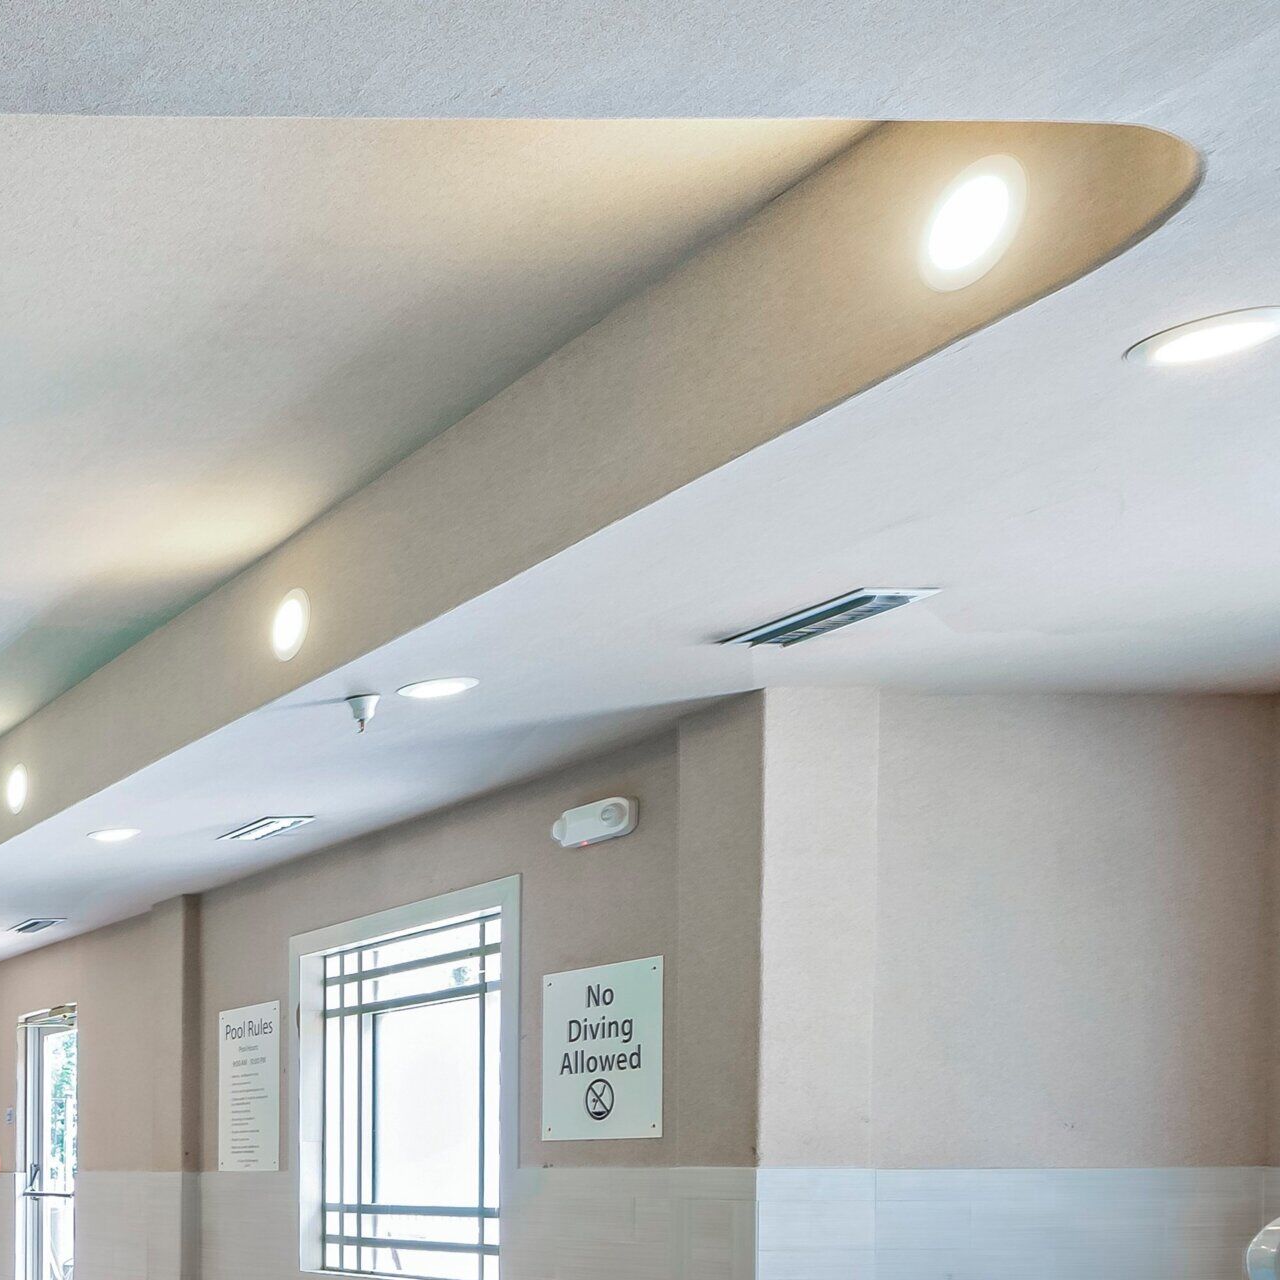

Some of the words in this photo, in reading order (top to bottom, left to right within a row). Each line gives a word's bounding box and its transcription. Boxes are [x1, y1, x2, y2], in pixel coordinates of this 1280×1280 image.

[586, 983, 615, 1008] No
[225, 1020, 246, 1040] Pool
[248, 1018, 273, 1037] Rules
[568, 1016, 633, 1044] Diving
[559, 1044, 642, 1075] Allowed
